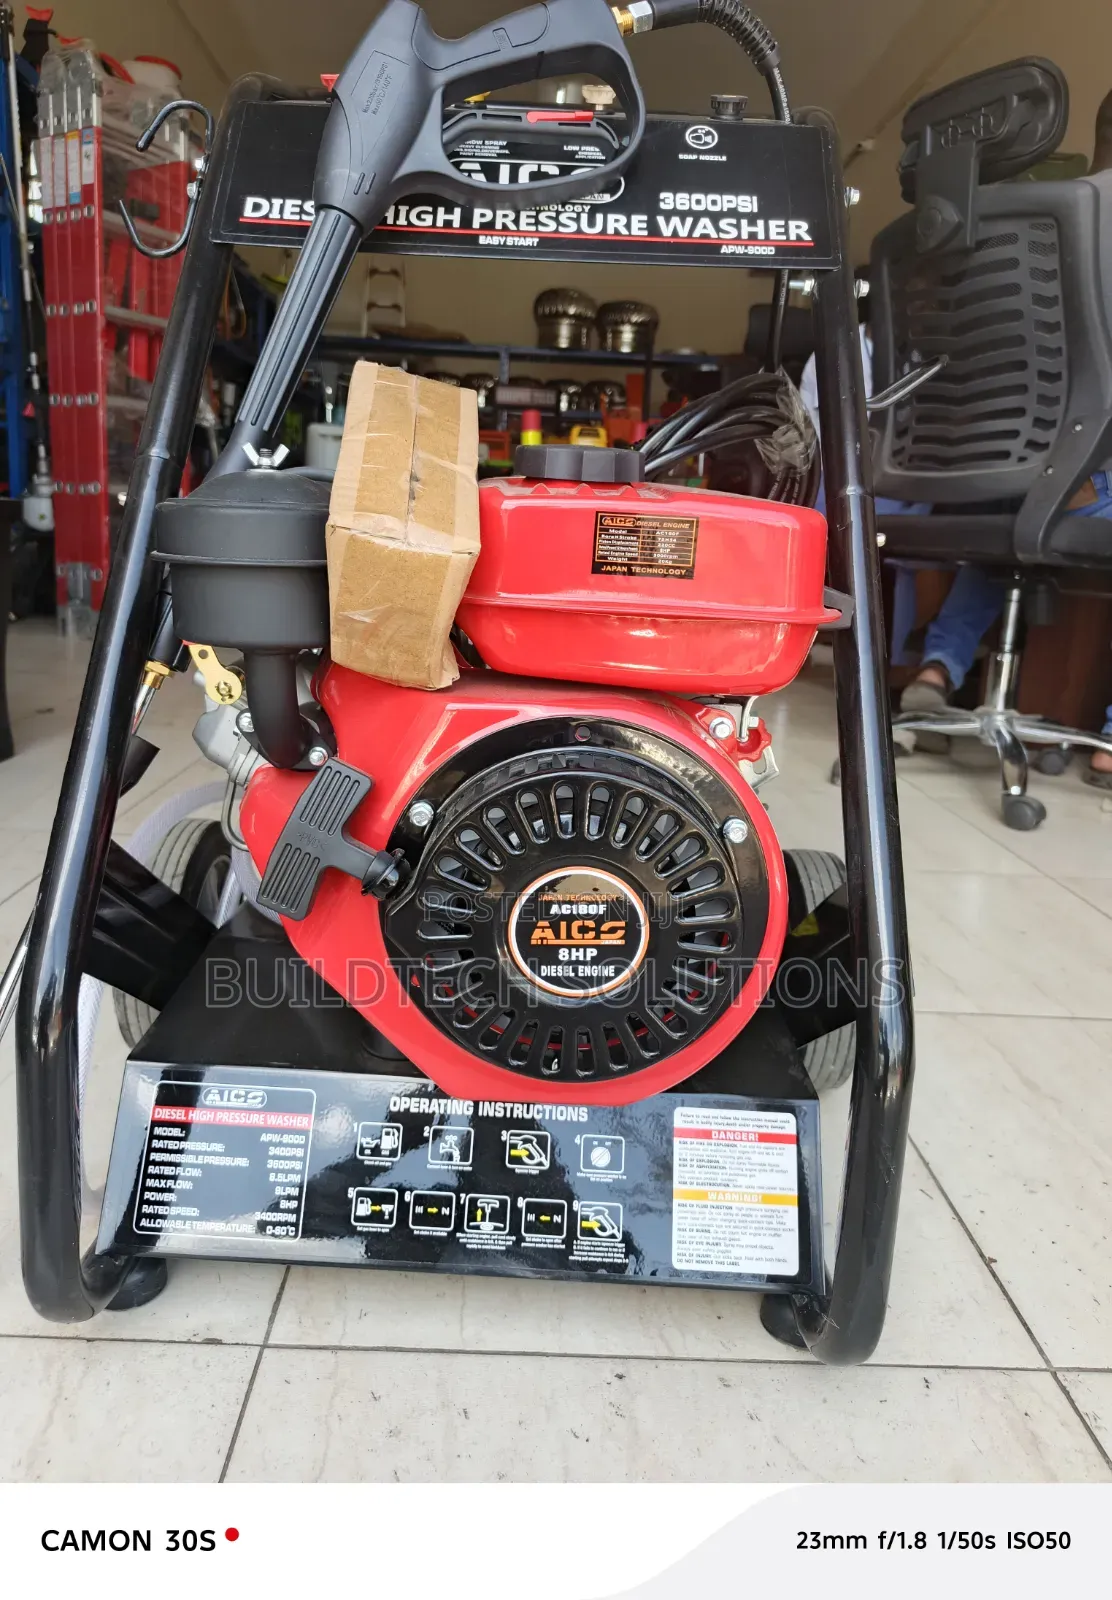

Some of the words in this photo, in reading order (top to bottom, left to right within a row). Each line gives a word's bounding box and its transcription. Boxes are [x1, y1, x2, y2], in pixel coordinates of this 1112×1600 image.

[659, 192, 758, 213] 3600PSI
[243, 196, 315, 220] DIES
[472, 207, 648, 236] PRESSURE
[656, 215, 812, 240] WASHER
[631, 566, 686, 575] TECHNOLOGY
[550, 904, 607, 915] AC180F
[531, 921, 626, 943] AICS
[558, 948, 598, 961] 8HP
[540, 966, 575, 977] DIESEL
[578, 966, 615, 977] ENGINE
[389, 1096, 474, 1117] OPERATING
[478, 1101, 589, 1123] INSTRUCTIONS
[154, 1108, 186, 1121] DIESEL
[188, 1110, 215, 1123] HIGH
[216, 1111, 265, 1125] PRESSURE
[267, 1114, 309, 1127] WASHER
[153, 1127, 186, 1137] MODEL:
[353, 1122, 358, 1133] 1
[423, 1126, 430, 1138] 2
[501, 1130, 508, 1141] 3
[574, 1134, 580, 1146] 4
[711, 1130, 759, 1142] DANGER!
[151, 1139, 179, 1150] RATED
[179, 1141, 226, 1153] PRESSURE:
[268, 1146, 304, 1158] 3400PSI
[150, 1153, 204, 1164] PERMISSIBLE
[203, 1155, 250, 1167] PRESSURE:
[267, 1159, 303, 1171] 3600PSI
[147, 1166, 175, 1176] RATED
[175, 1167, 202, 1177] FLOW:
[146, 1179, 166, 1189] MAX
[166, 1179, 193, 1190] FLOW:
[144, 1191, 177, 1202] POWER:
[348, 1187, 355, 1199] 5
[404, 1191, 411, 1202] 6
[460, 1193, 466, 1205] 7
[517, 1197, 524, 1208] 8
[572, 1200, 578, 1211] 9
[142, 1204, 170, 1215] RATED
[170, 1206, 200, 1217] SPEED:
[139, 1217, 191, 1229] ALLOWABLE
[191, 1220, 256, 1233] TEMPERATURE:
